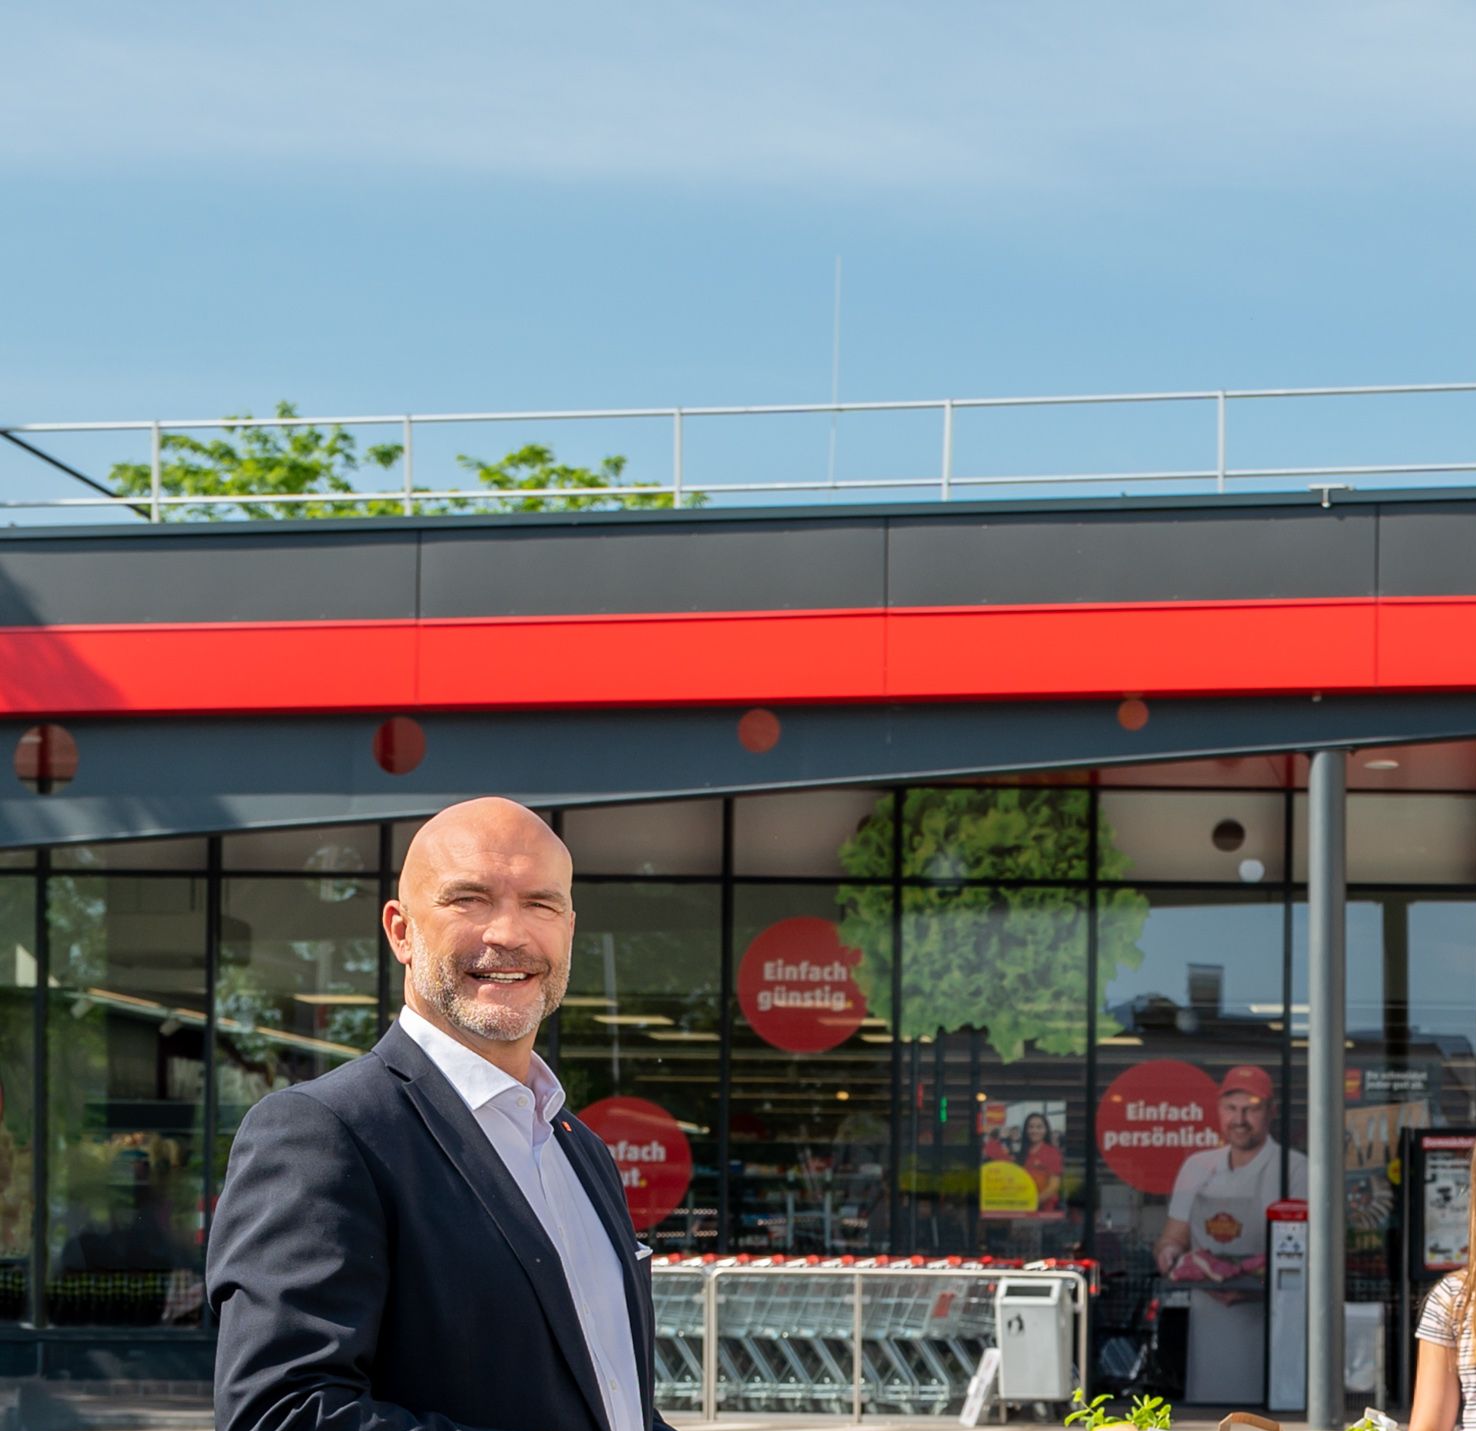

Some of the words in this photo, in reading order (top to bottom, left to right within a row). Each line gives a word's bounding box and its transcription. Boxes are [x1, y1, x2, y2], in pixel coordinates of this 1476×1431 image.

[763, 958, 848, 982] Einfach
[757, 985, 853, 1011] günstig.
[1125, 1099, 1204, 1121] Einfach
[1103, 1126, 1225, 1150] persönlich.
[607, 1140, 667, 1162] nfach
[620, 1168, 647, 1188] ut.
